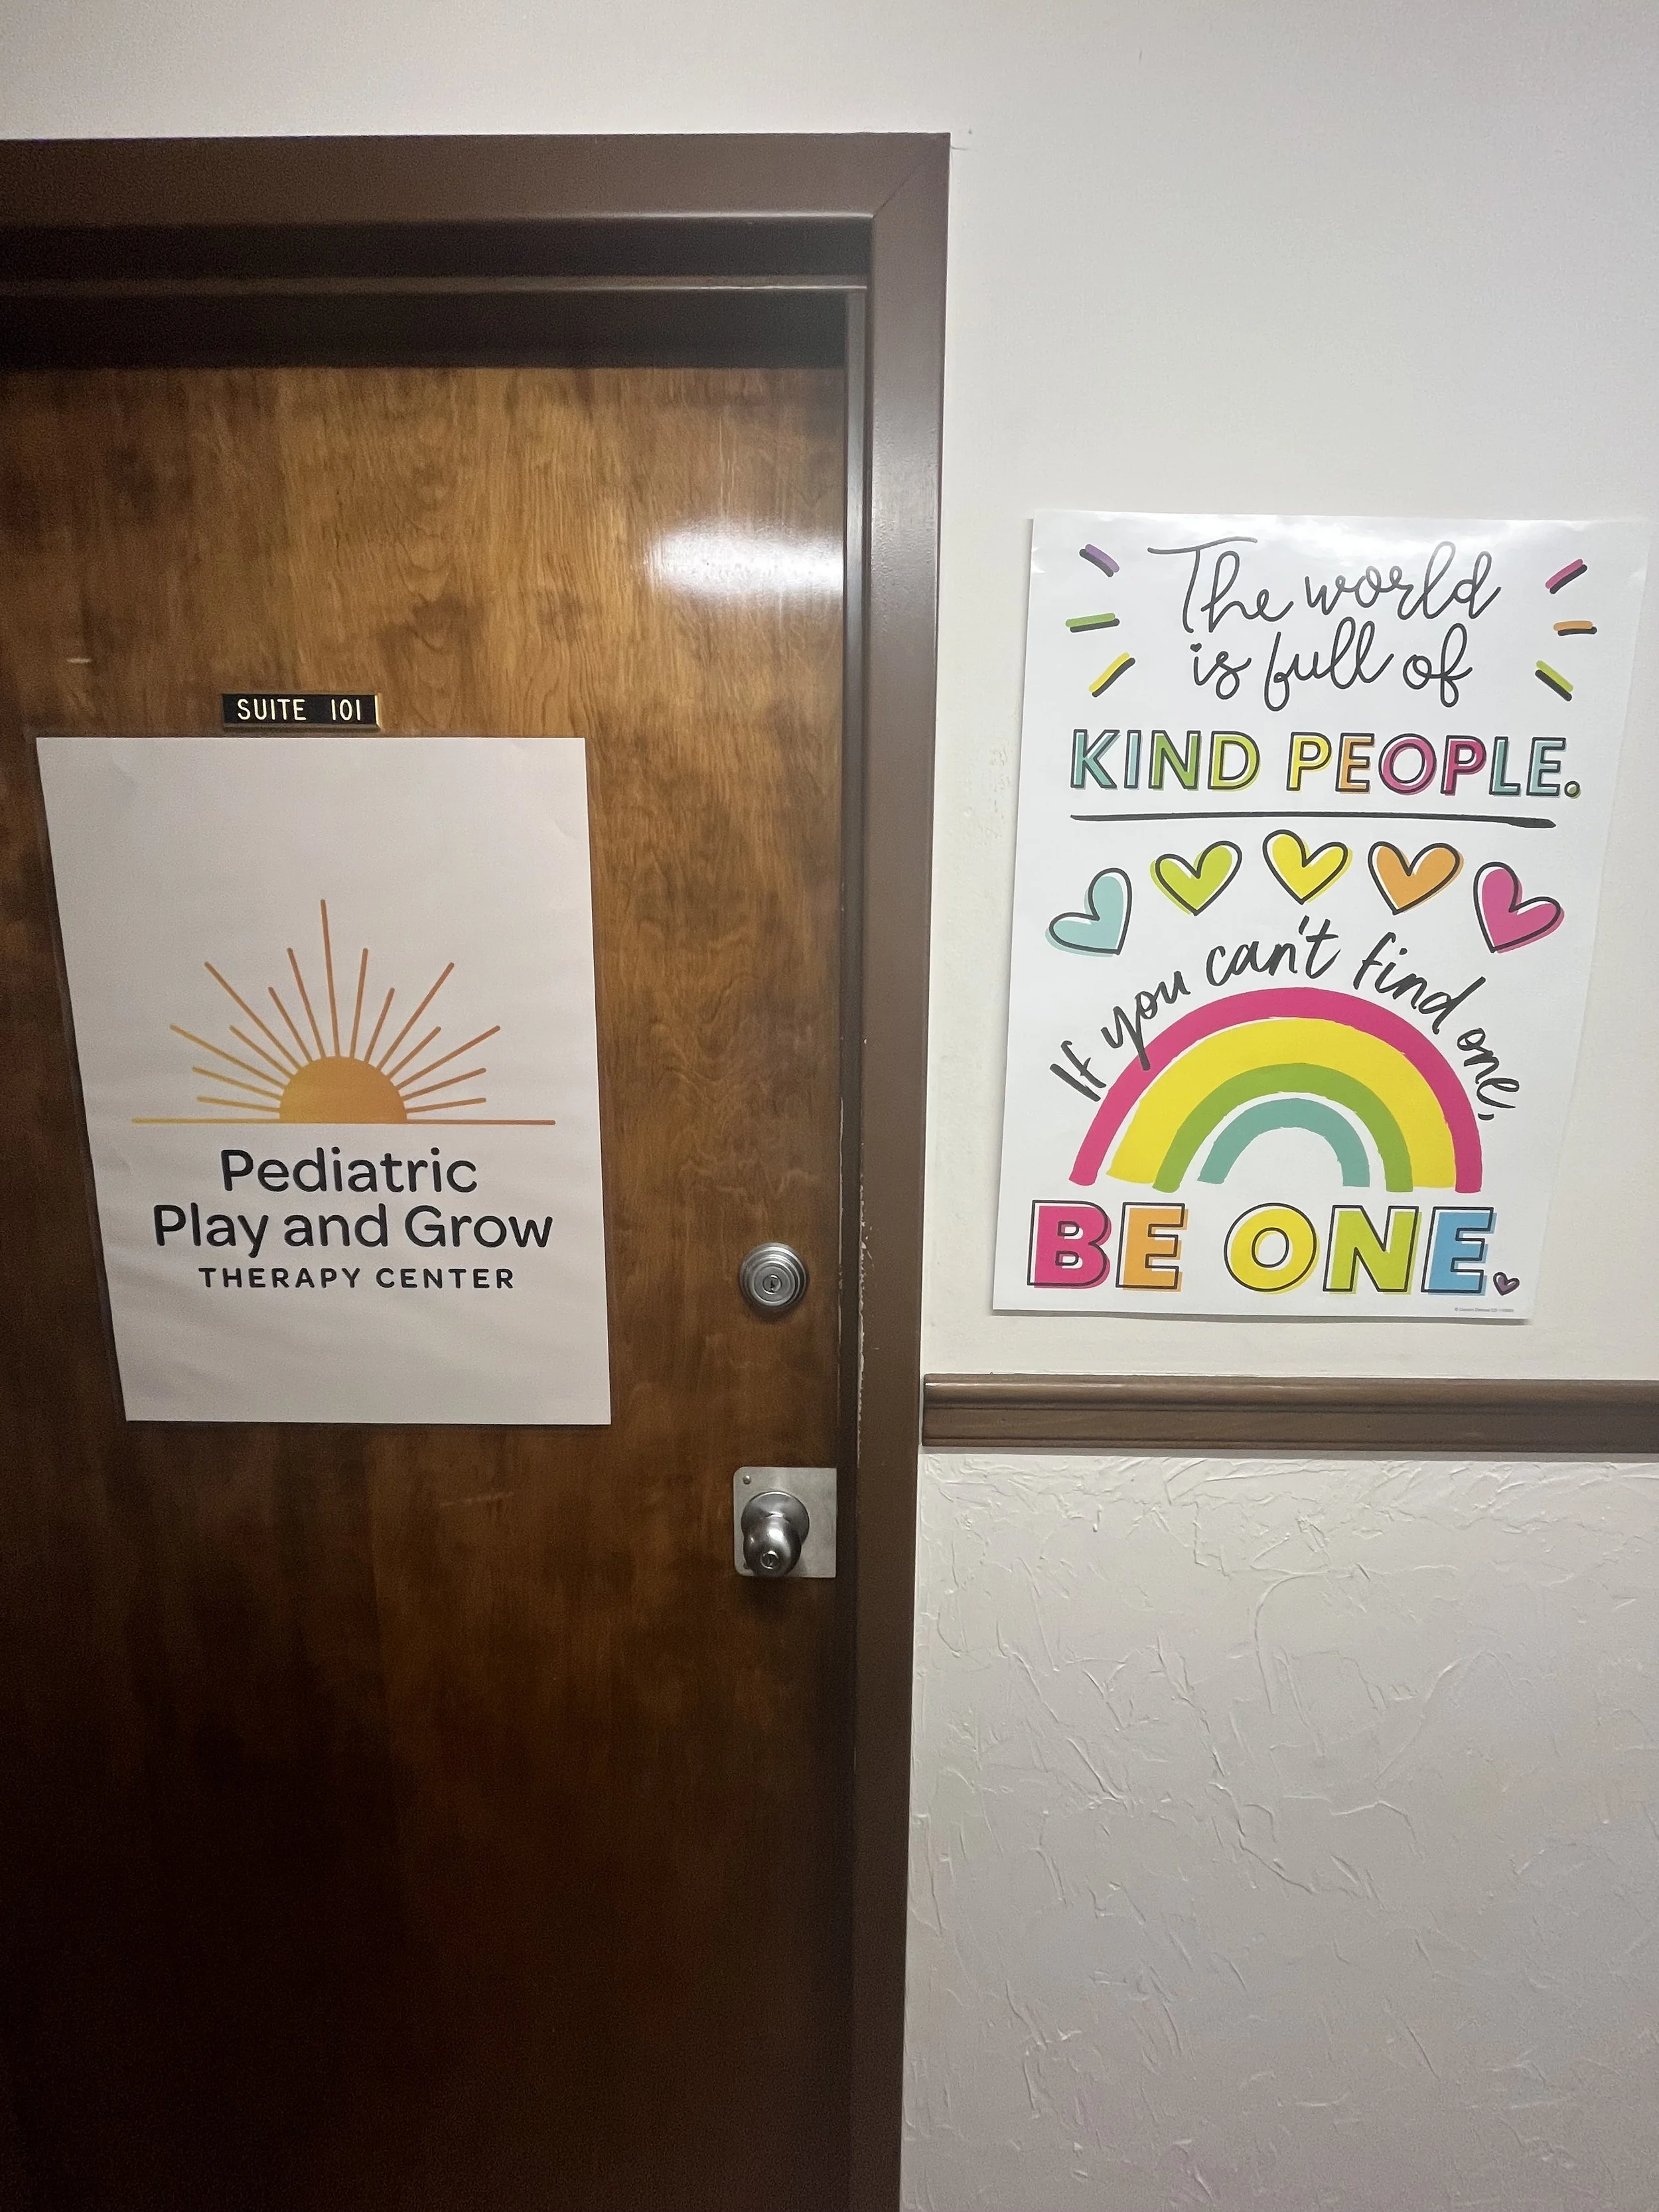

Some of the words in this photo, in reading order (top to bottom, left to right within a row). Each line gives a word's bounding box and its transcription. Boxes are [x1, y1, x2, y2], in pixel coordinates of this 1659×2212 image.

[1147, 536, 1295, 632] The
[1305, 542, 1501, 620] world
[1190, 643, 1253, 698] is
[1264, 617, 1395, 711] full
[1403, 623, 1473, 707] of
[238, 698, 307, 721] SUITE
[331, 699, 361, 721] 101
[1070, 729, 1260, 792] KIND
[1287, 731, 1581, 798] PEOPLE.
[1050, 1041, 1107, 1103] If
[1101, 971, 1192, 1070] you
[1205, 915, 1341, 986] can't
[1354, 932, 1486, 1034] find
[1457, 1026, 1522, 1122] one,
[220, 1145, 478, 1193] Pediatric
[153, 1203, 269, 1258] Play
[283, 1203, 388, 1248] and
[404, 1204, 553, 1248] Grow
[1027, 1199, 1189, 1291] BE
[198, 1267, 361, 1289] THERAPY
[376, 1268, 514, 1290] CENTER
